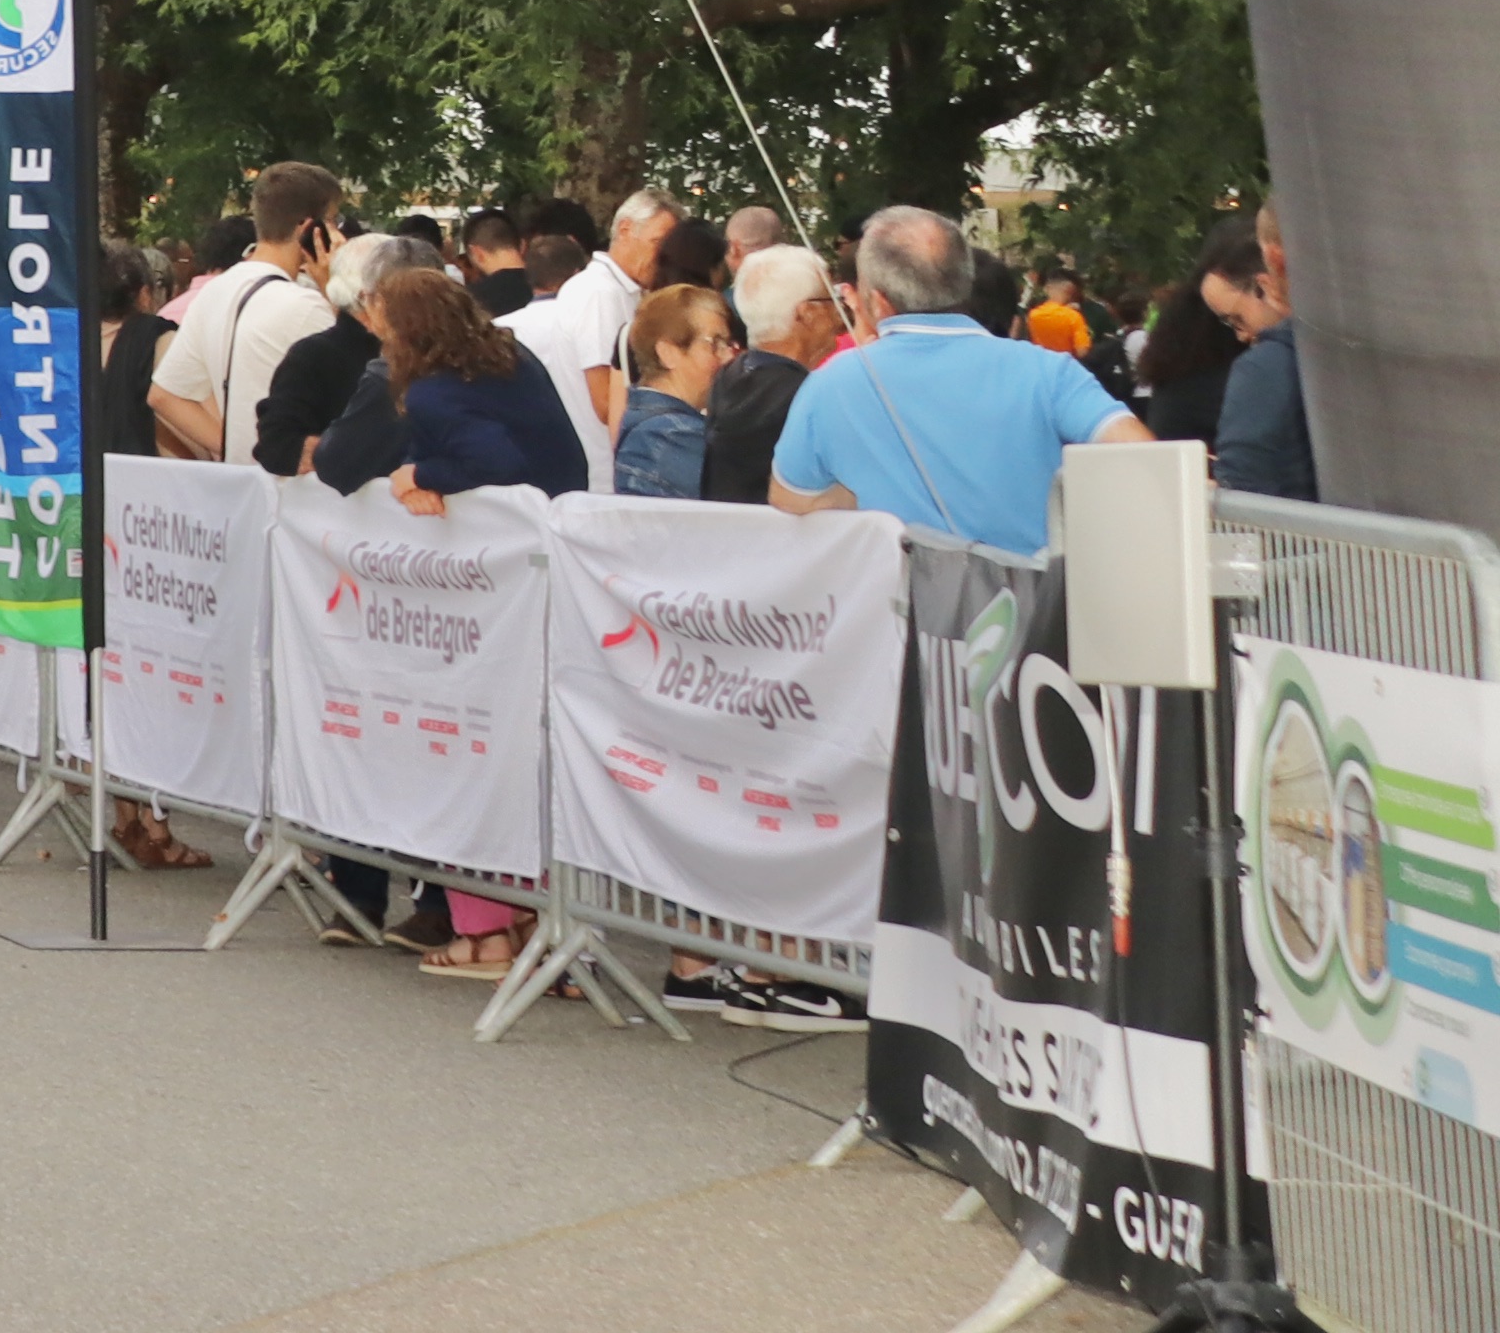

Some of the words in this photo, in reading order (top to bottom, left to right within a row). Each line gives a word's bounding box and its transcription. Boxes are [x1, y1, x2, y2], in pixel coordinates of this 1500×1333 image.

[123, 501, 169, 552] Crédit
[171, 511, 230, 564] Mutuel
[124, 554, 143, 600] de
[146, 561, 218, 624] Bretagne
[349, 540, 411, 587] Crédit
[409, 545, 496, 592] Mutuel
[367, 590, 390, 642] de
[392, 597, 482, 664] Bretagne
[639, 590, 732, 646] Crédit
[722, 594, 835, 653] Mutuel
[656, 642, 695, 700] de
[689, 653, 817, 731] Bretagne
